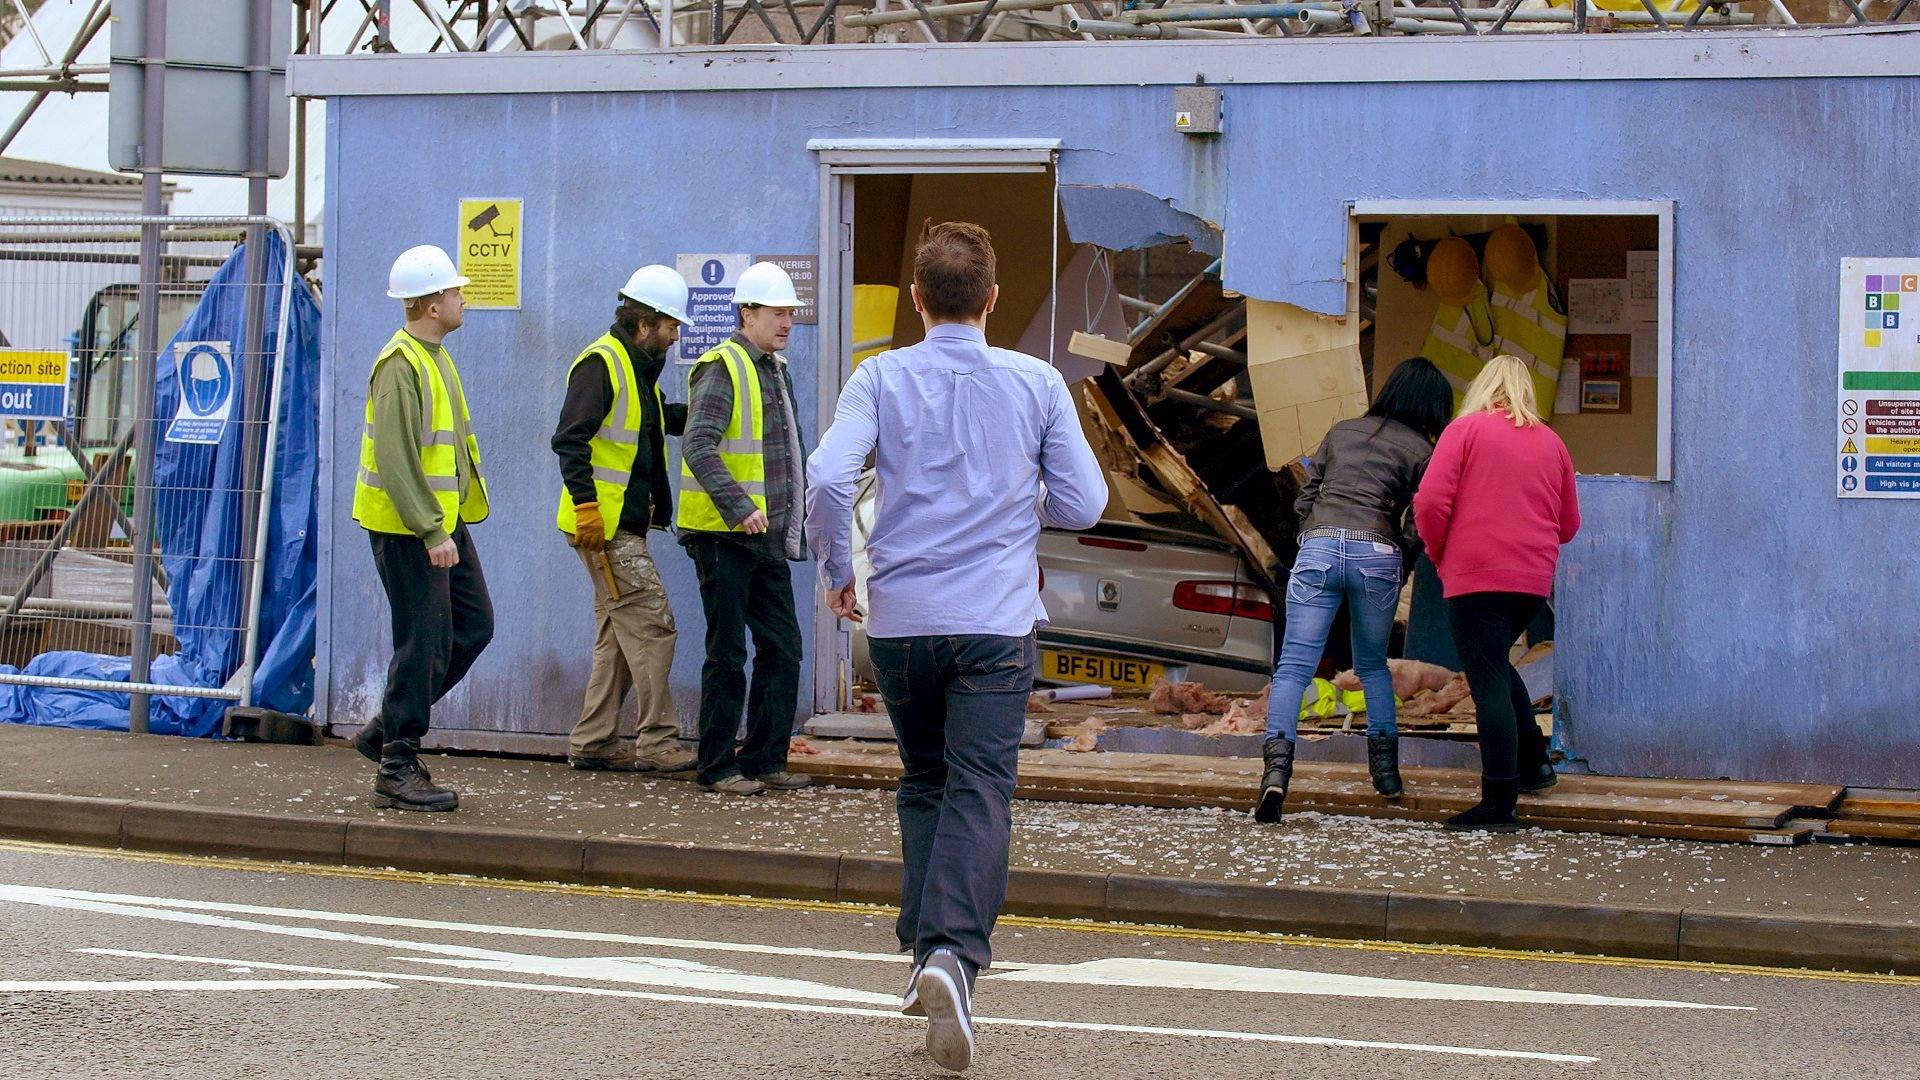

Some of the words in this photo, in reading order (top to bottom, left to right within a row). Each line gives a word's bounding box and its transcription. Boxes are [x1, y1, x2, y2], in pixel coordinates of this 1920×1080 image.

[469, 244, 510, 257] CCTV
[770, 261, 812, 269] IVERIES
[790, 272, 812, 280] 18:00
[1904, 278, 1914, 290] C
[692, 292, 733, 302] Approved
[1869, 296, 1878, 308] B
[693, 303, 732, 312] personal
[690, 313, 735, 323] protective
[1886, 315, 1895, 326] B
[688, 324, 736, 335] equipment
[681, 335, 705, 343] must
[706, 334, 718, 343] be
[687, 345, 697, 354] at
[0, 360, 32, 375] ction
[38, 361, 61, 376] site
[1, 388, 33, 409] out
[1890, 426, 1920, 435] authority
[1890, 438, 1911, 446] Heavy
[1875, 460, 1884, 468] All
[1886, 460, 1911, 468] visitors
[1880, 480, 1897, 488] High
[1057, 654, 1104, 679] BF51
[1110, 660, 1151, 684] UEY
